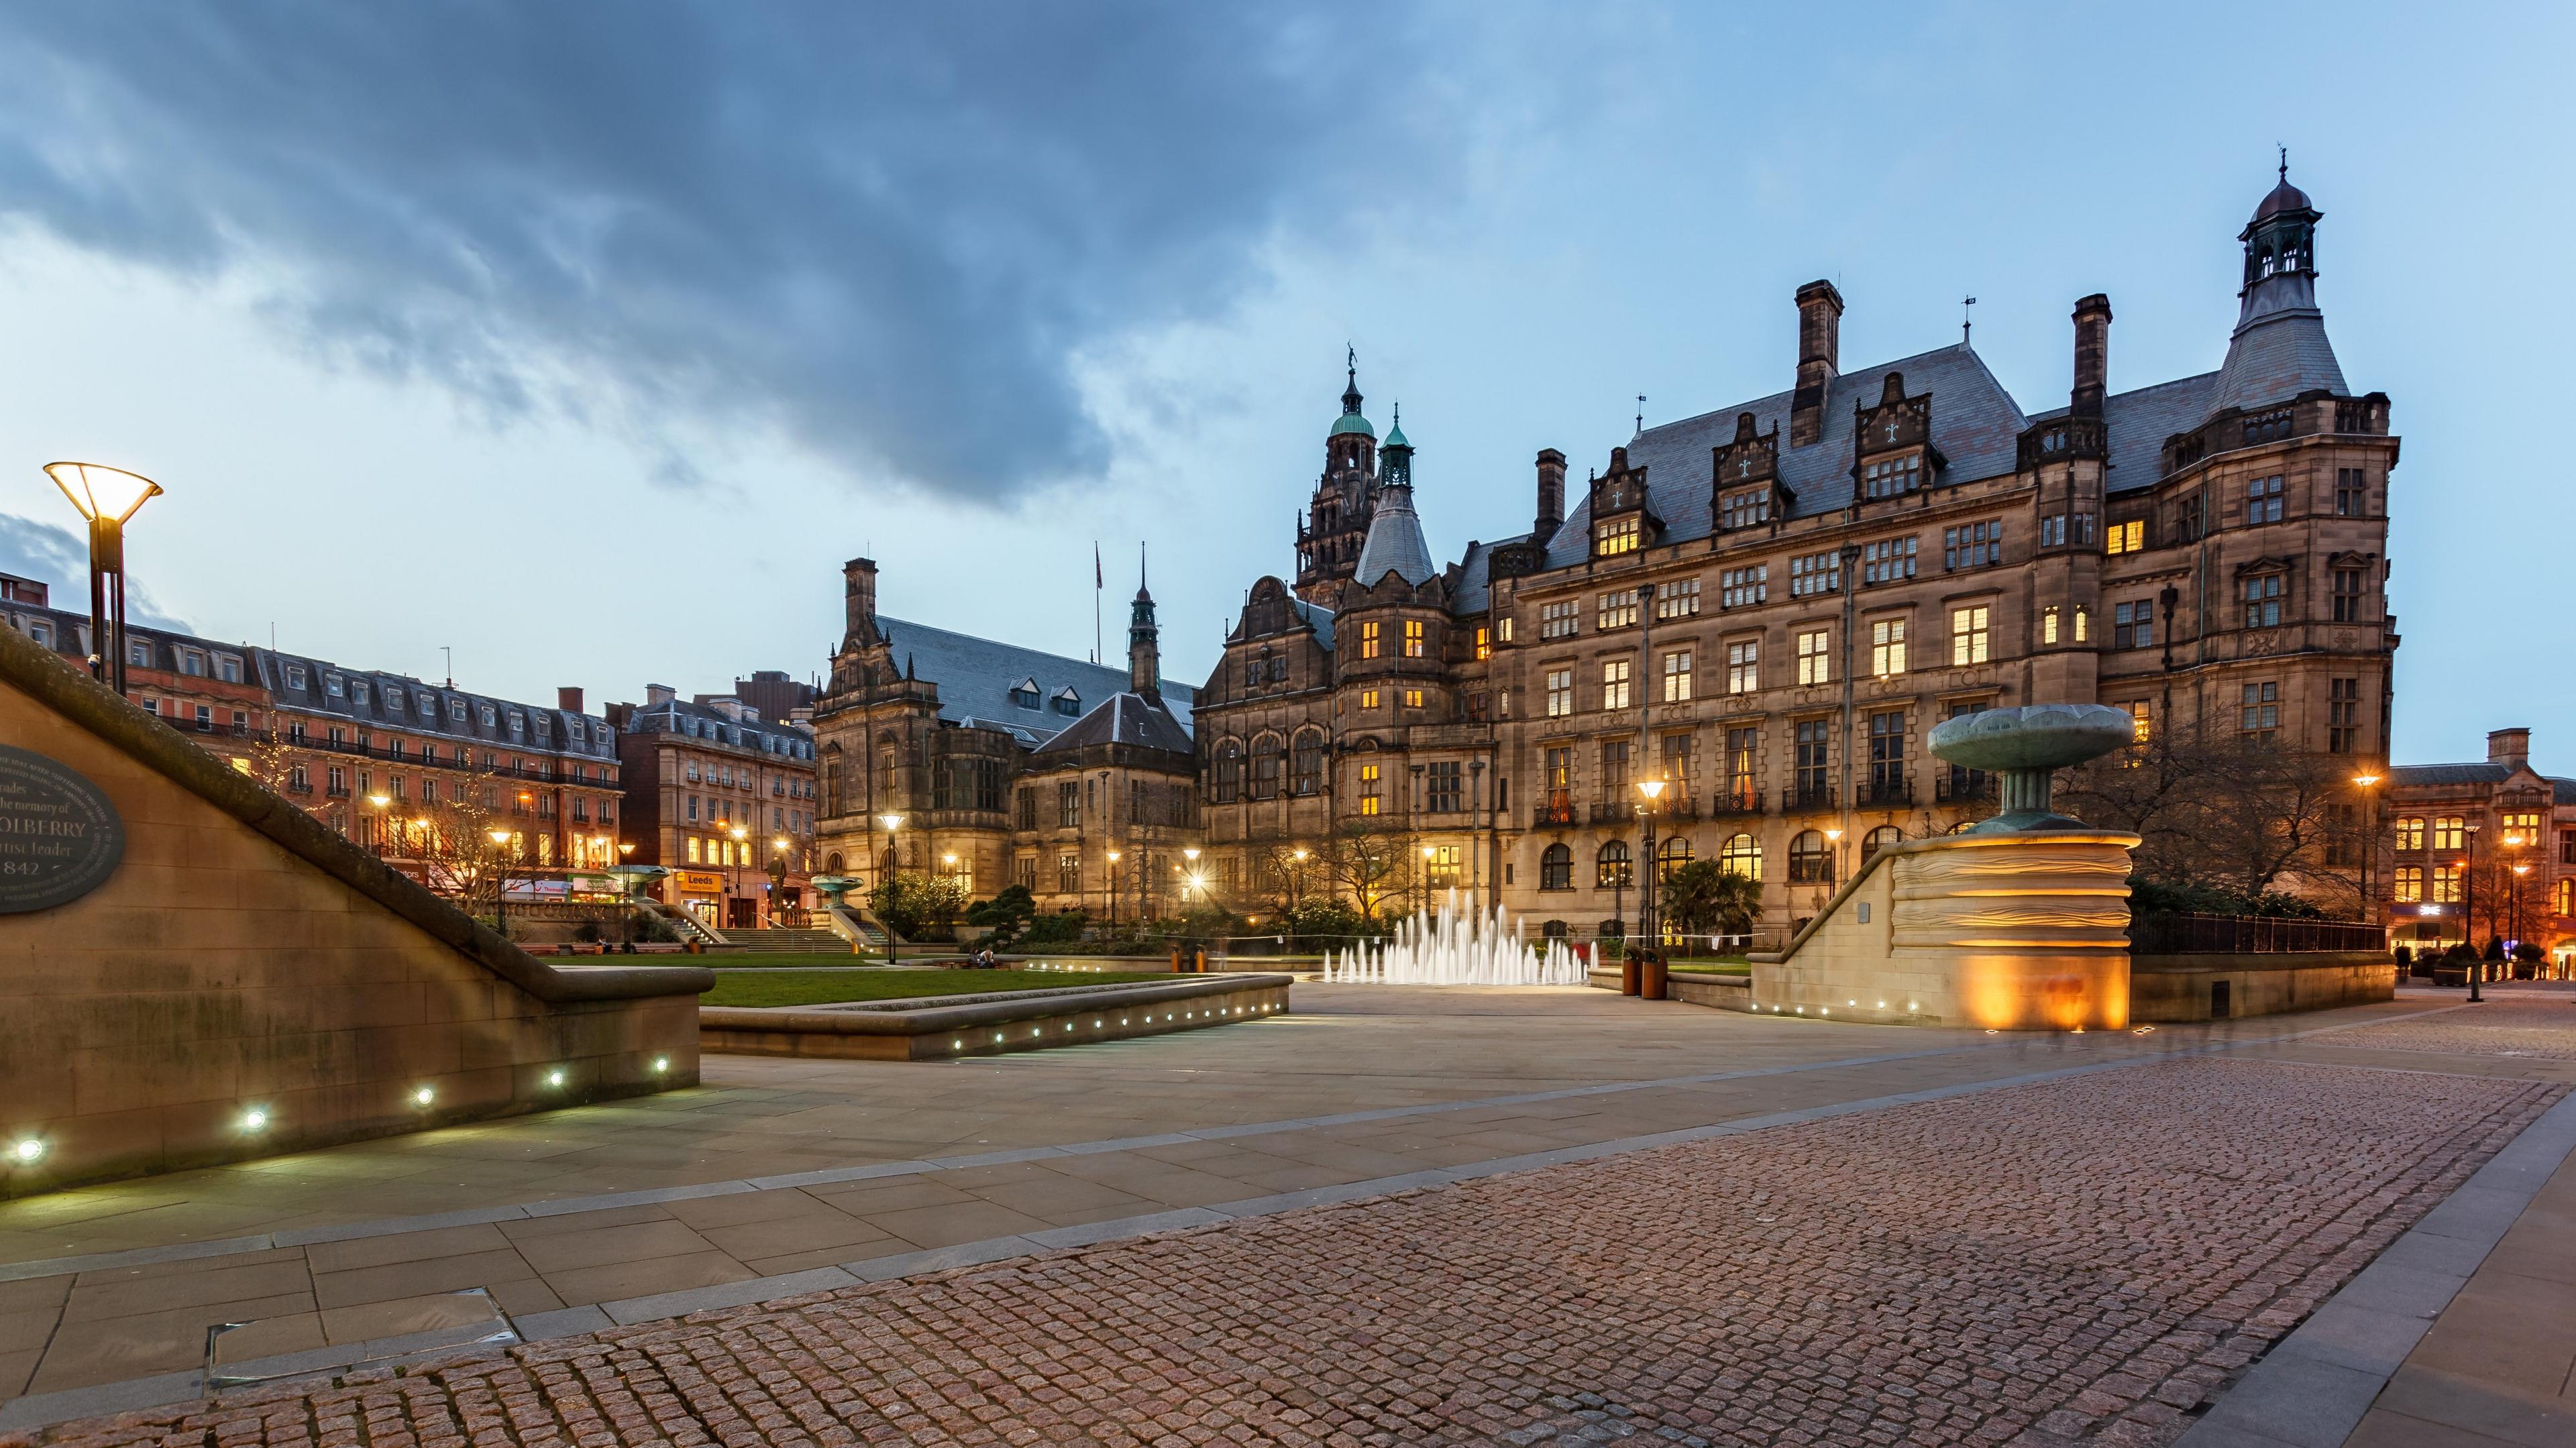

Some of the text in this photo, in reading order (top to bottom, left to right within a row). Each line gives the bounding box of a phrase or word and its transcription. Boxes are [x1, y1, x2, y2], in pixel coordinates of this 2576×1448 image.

[51, 772, 86, 795] SUFFERING
[85, 793, 97, 805] TWO
[95, 805, 108, 822] YEARS
[15, 800, 57, 816] memory
[58, 802, 71, 814] of
[0, 816, 87, 838] OLBERRY
[32, 842, 75, 857] leader
[4, 860, 41, 876] 842
[688, 875, 713, 885] Leeds
